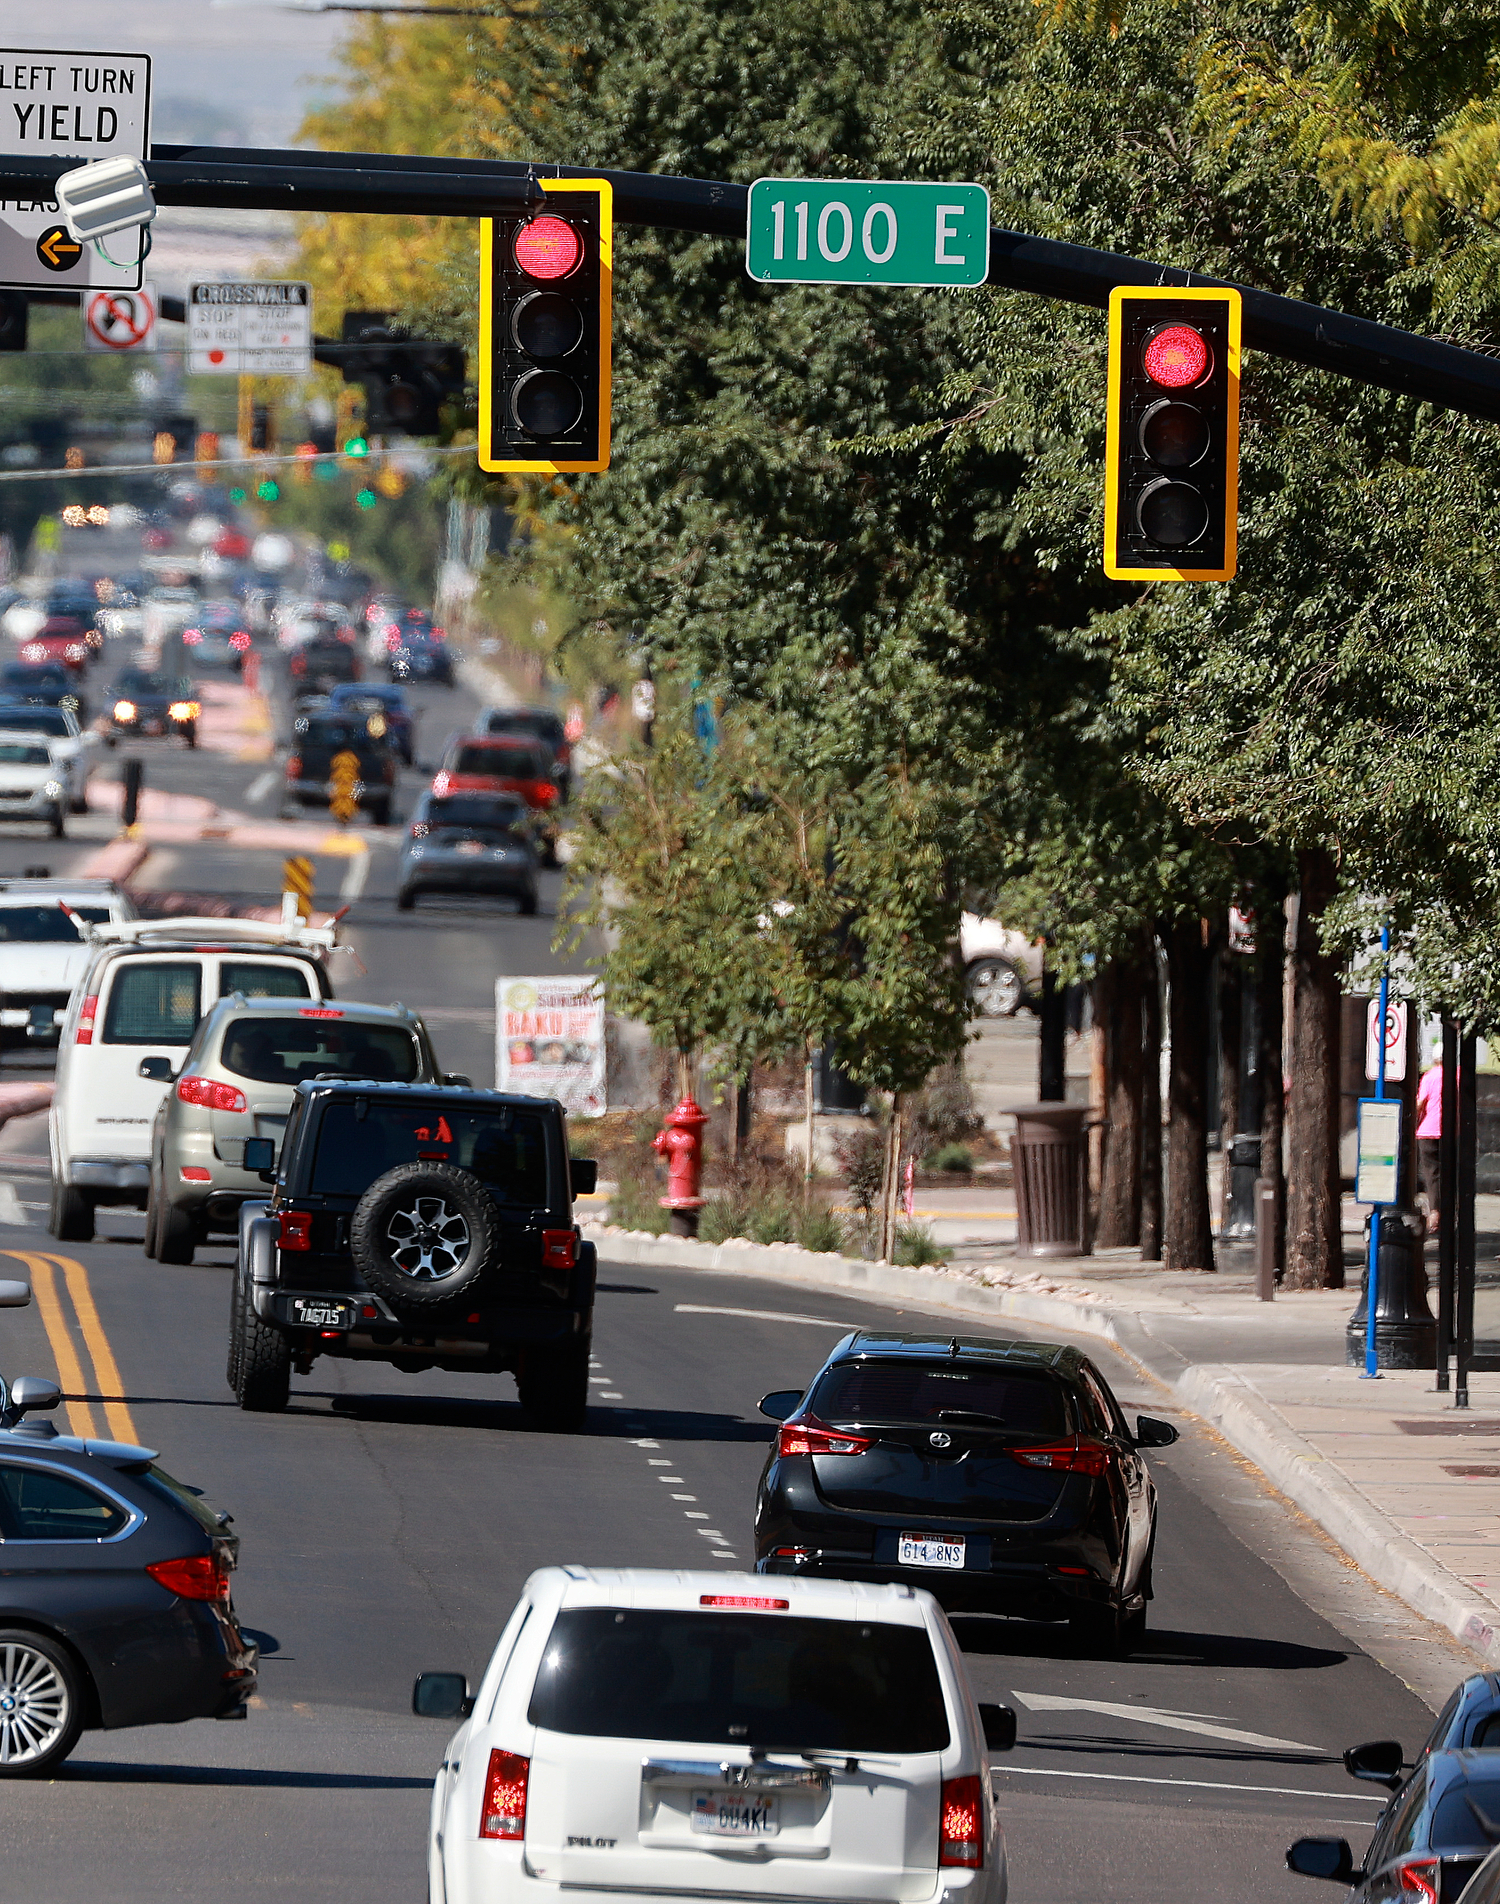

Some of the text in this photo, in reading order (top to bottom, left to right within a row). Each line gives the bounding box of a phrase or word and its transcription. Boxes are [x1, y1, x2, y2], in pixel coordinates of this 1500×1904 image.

[0, 64, 135, 94] LEFT TURN
[12, 102, 118, 143] YIELD
[771, 200, 966, 265] 1100 E
[197, 284, 302, 304] CROSSWALK
[936, 1545, 961, 1562] 8NS
[566, 1836, 618, 1848] PILOT
